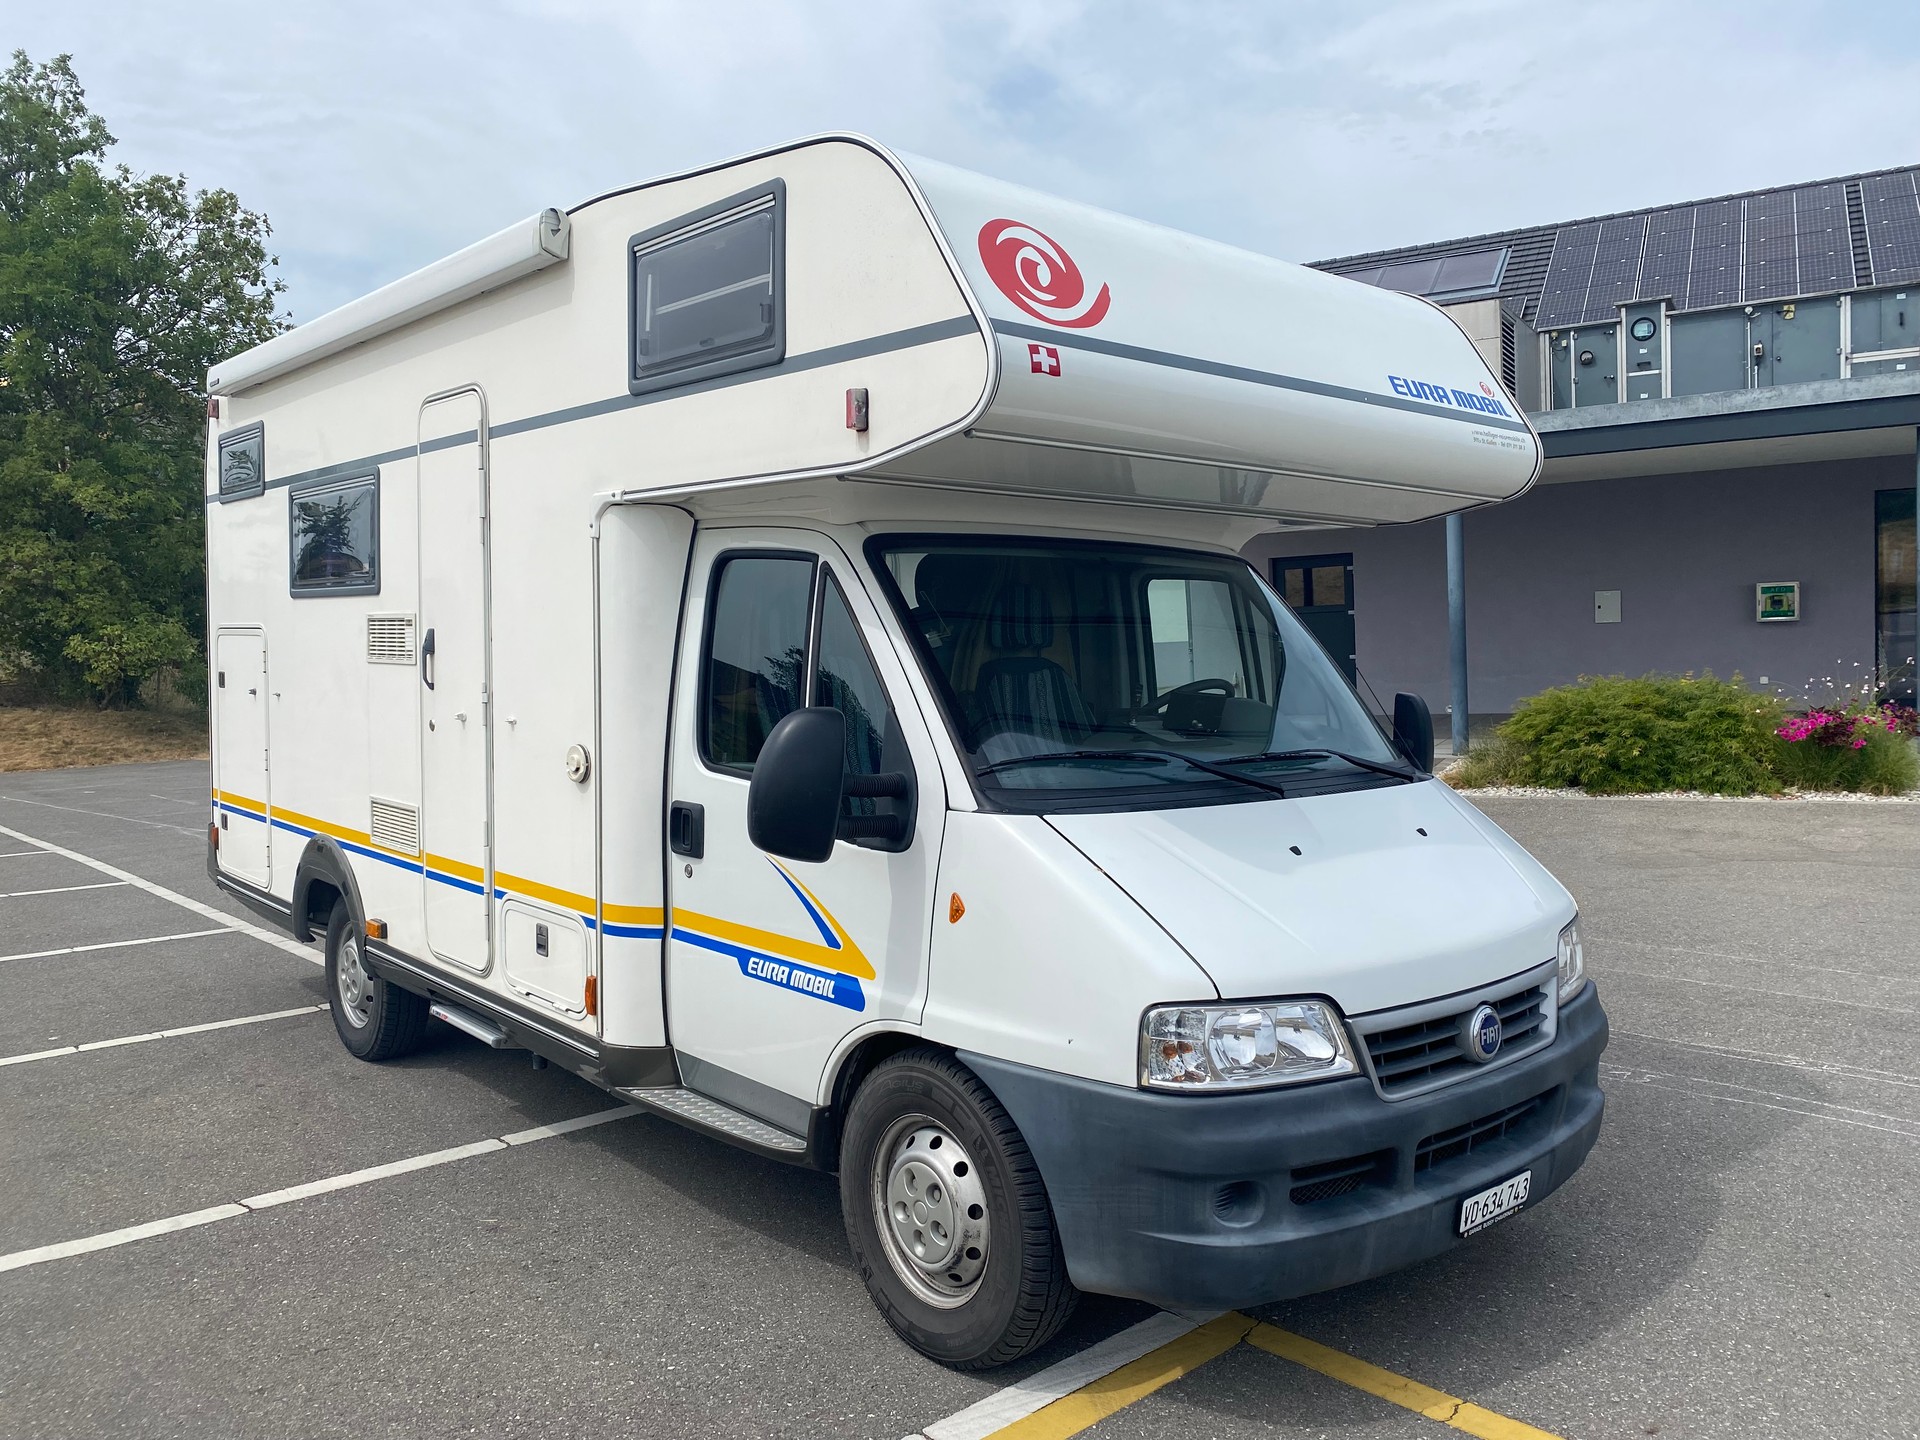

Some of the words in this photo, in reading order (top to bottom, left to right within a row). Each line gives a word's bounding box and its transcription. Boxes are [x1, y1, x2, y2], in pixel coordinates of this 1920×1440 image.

[1388, 375, 1452, 405] EURA
[1451, 389, 1512, 418] MOBIL
[747, 957, 790, 984] EURA
[790, 969, 835, 999] MOBIL
[1481, 1024, 1499, 1046] FIAT
